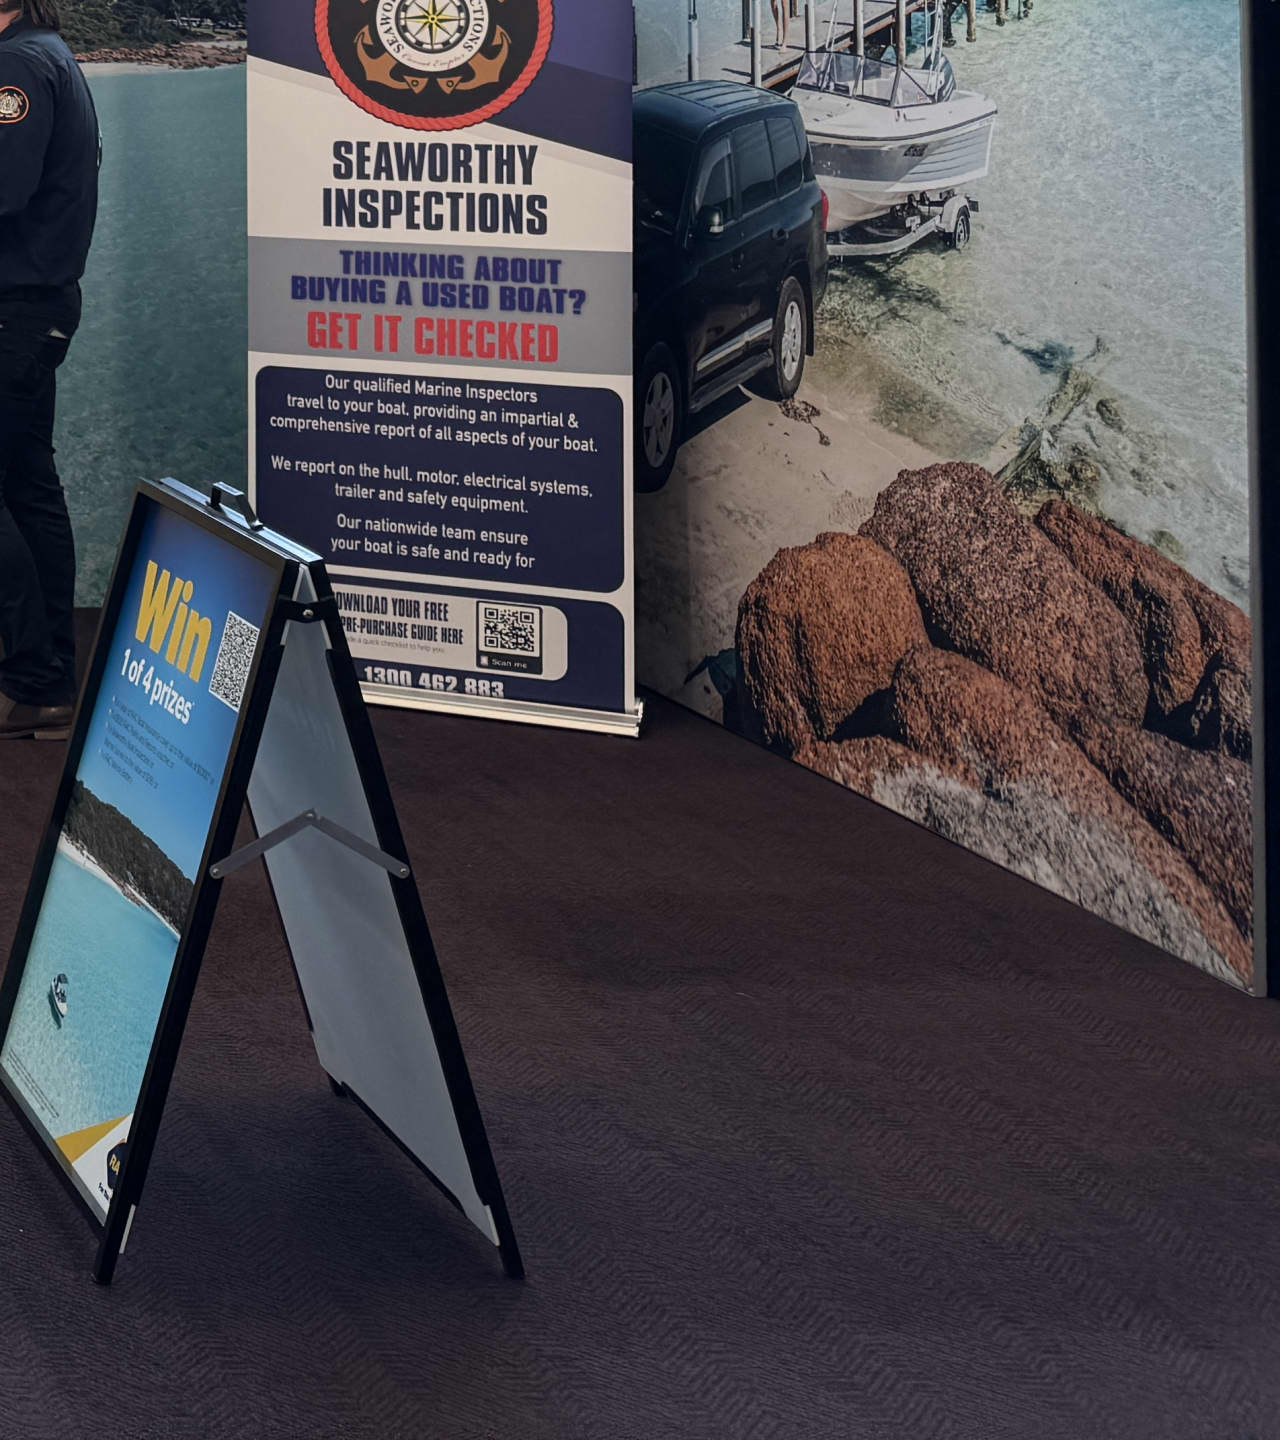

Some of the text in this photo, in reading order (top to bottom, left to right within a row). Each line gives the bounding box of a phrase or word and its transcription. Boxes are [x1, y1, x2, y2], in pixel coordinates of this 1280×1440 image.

[332, 140, 538, 186] SEAWORTHY
[323, 187, 548, 235] INSPECTIONS
[339, 249, 562, 285] THINKING ABOUT
[291, 275, 587, 315] BUYING A USED BOAT?
[307, 311, 559, 363] GET IT CHECKED
[325, 375, 538, 404] Our qualified Marine Inspectors
[287, 394, 324, 410] travel
[327, 396, 340, 410] to
[343, 400, 374, 415] your
[413, 402, 477, 425] providing
[480, 410, 497, 423] an
[501, 408, 564, 428] impartial
[568, 413, 579, 429] &
[270, 415, 598, 453] comprehensive report of all aspects of your boat.
[271, 455, 292, 471] We
[295, 459, 336, 477] report
[339, 464, 356, 476] on
[359, 462, 380, 478] the
[463, 472, 527, 492] electrical
[530, 479, 593, 498] systems,
[335, 482, 529, 514] trailer and safety equipment.
[337, 513, 529, 546] Our nationwide team ensure
[330, 537, 536, 570] your boat is safe and ready for
[135, 559, 212, 684] Win
[334, 591, 449, 622] OWNLOAD YOUR FREE
[340, 616, 464, 645] PRE-PURCHASE GUIDE HERE
[121, 648, 131, 677] 1
[128, 658, 146, 687] of
[142, 665, 155, 694] 4
[364, 665, 412, 687] 1300
[418, 672, 458, 693] 462
[492, 658, 512, 669] Scan
[109, 1153, 121, 1176] RA
